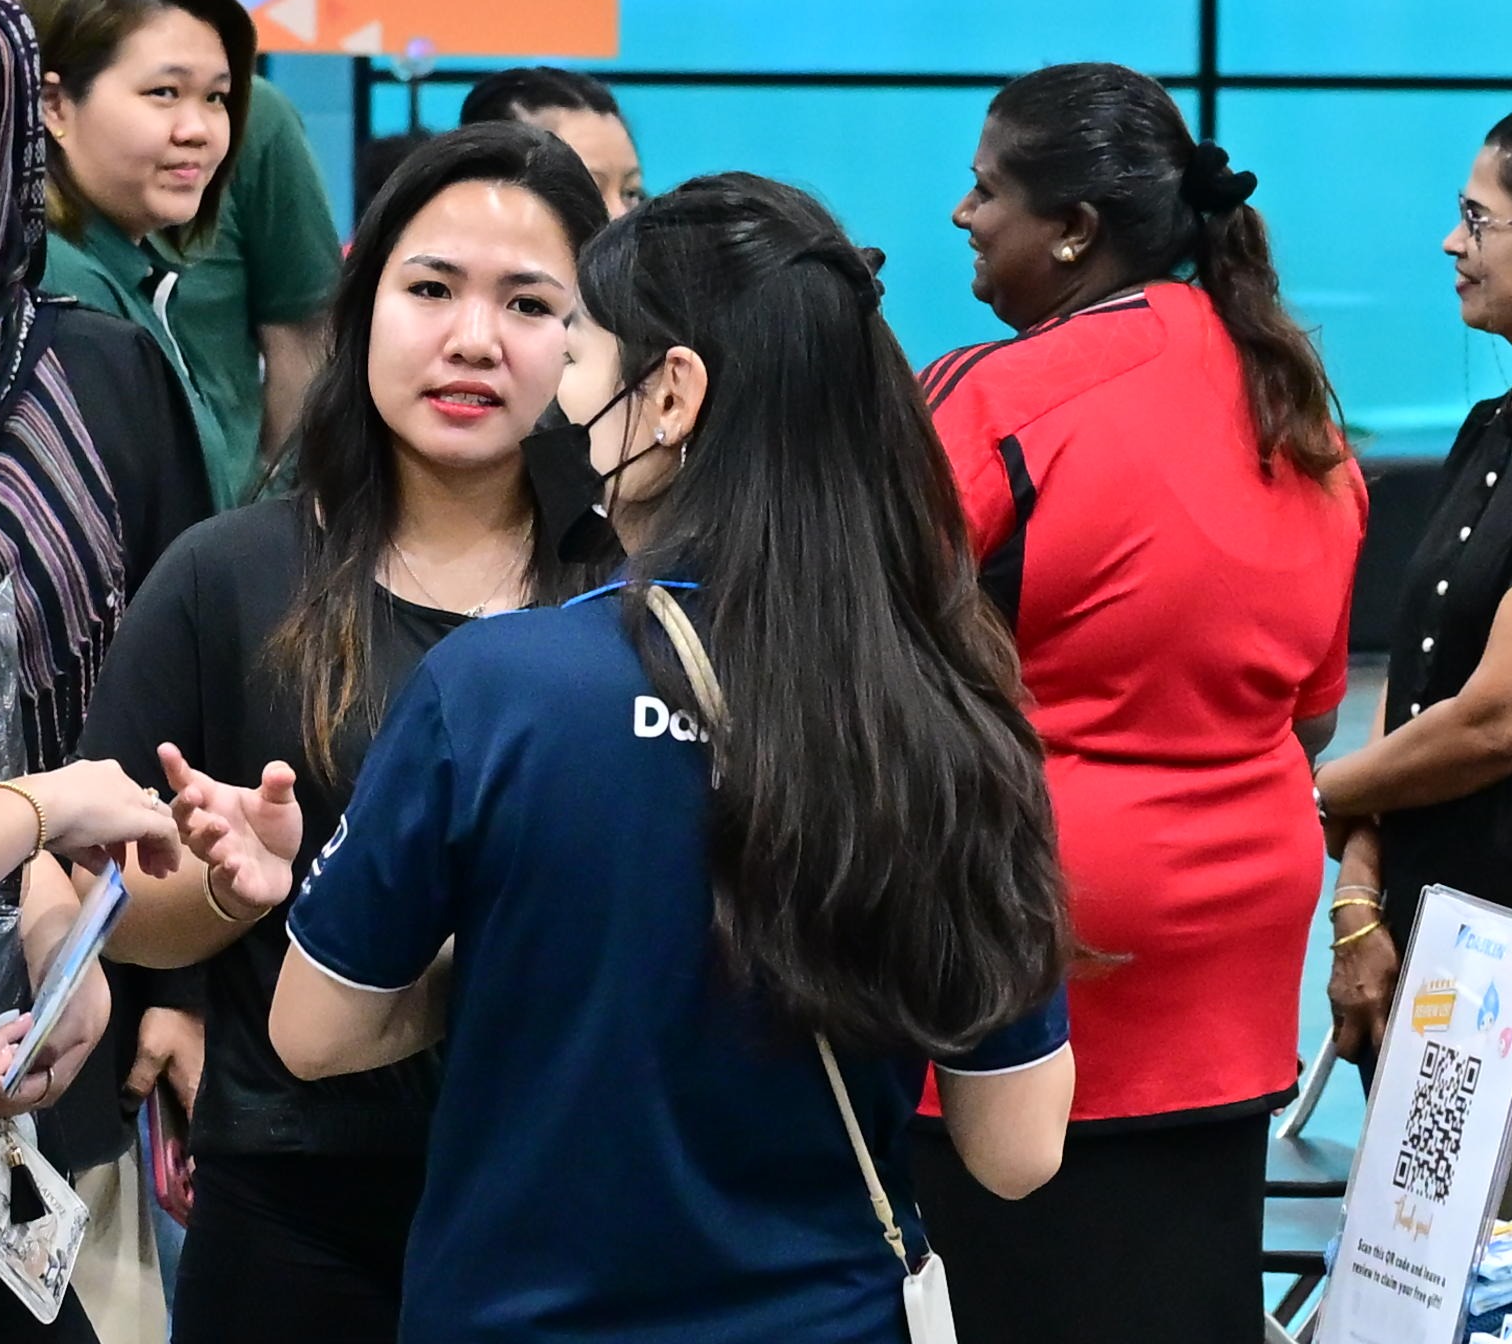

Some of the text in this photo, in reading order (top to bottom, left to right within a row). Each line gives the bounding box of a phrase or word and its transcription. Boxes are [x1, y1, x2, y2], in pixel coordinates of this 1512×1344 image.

[1352, 1261, 1372, 1279] review
[1373, 1270, 1380, 1282] to
[1381, 1271, 1397, 1290] claim
[1398, 1281, 1412, 1296] your
[1413, 1285, 1426, 1303] free
[1358, 1238, 1446, 1288] Scan this QR code and leave a
